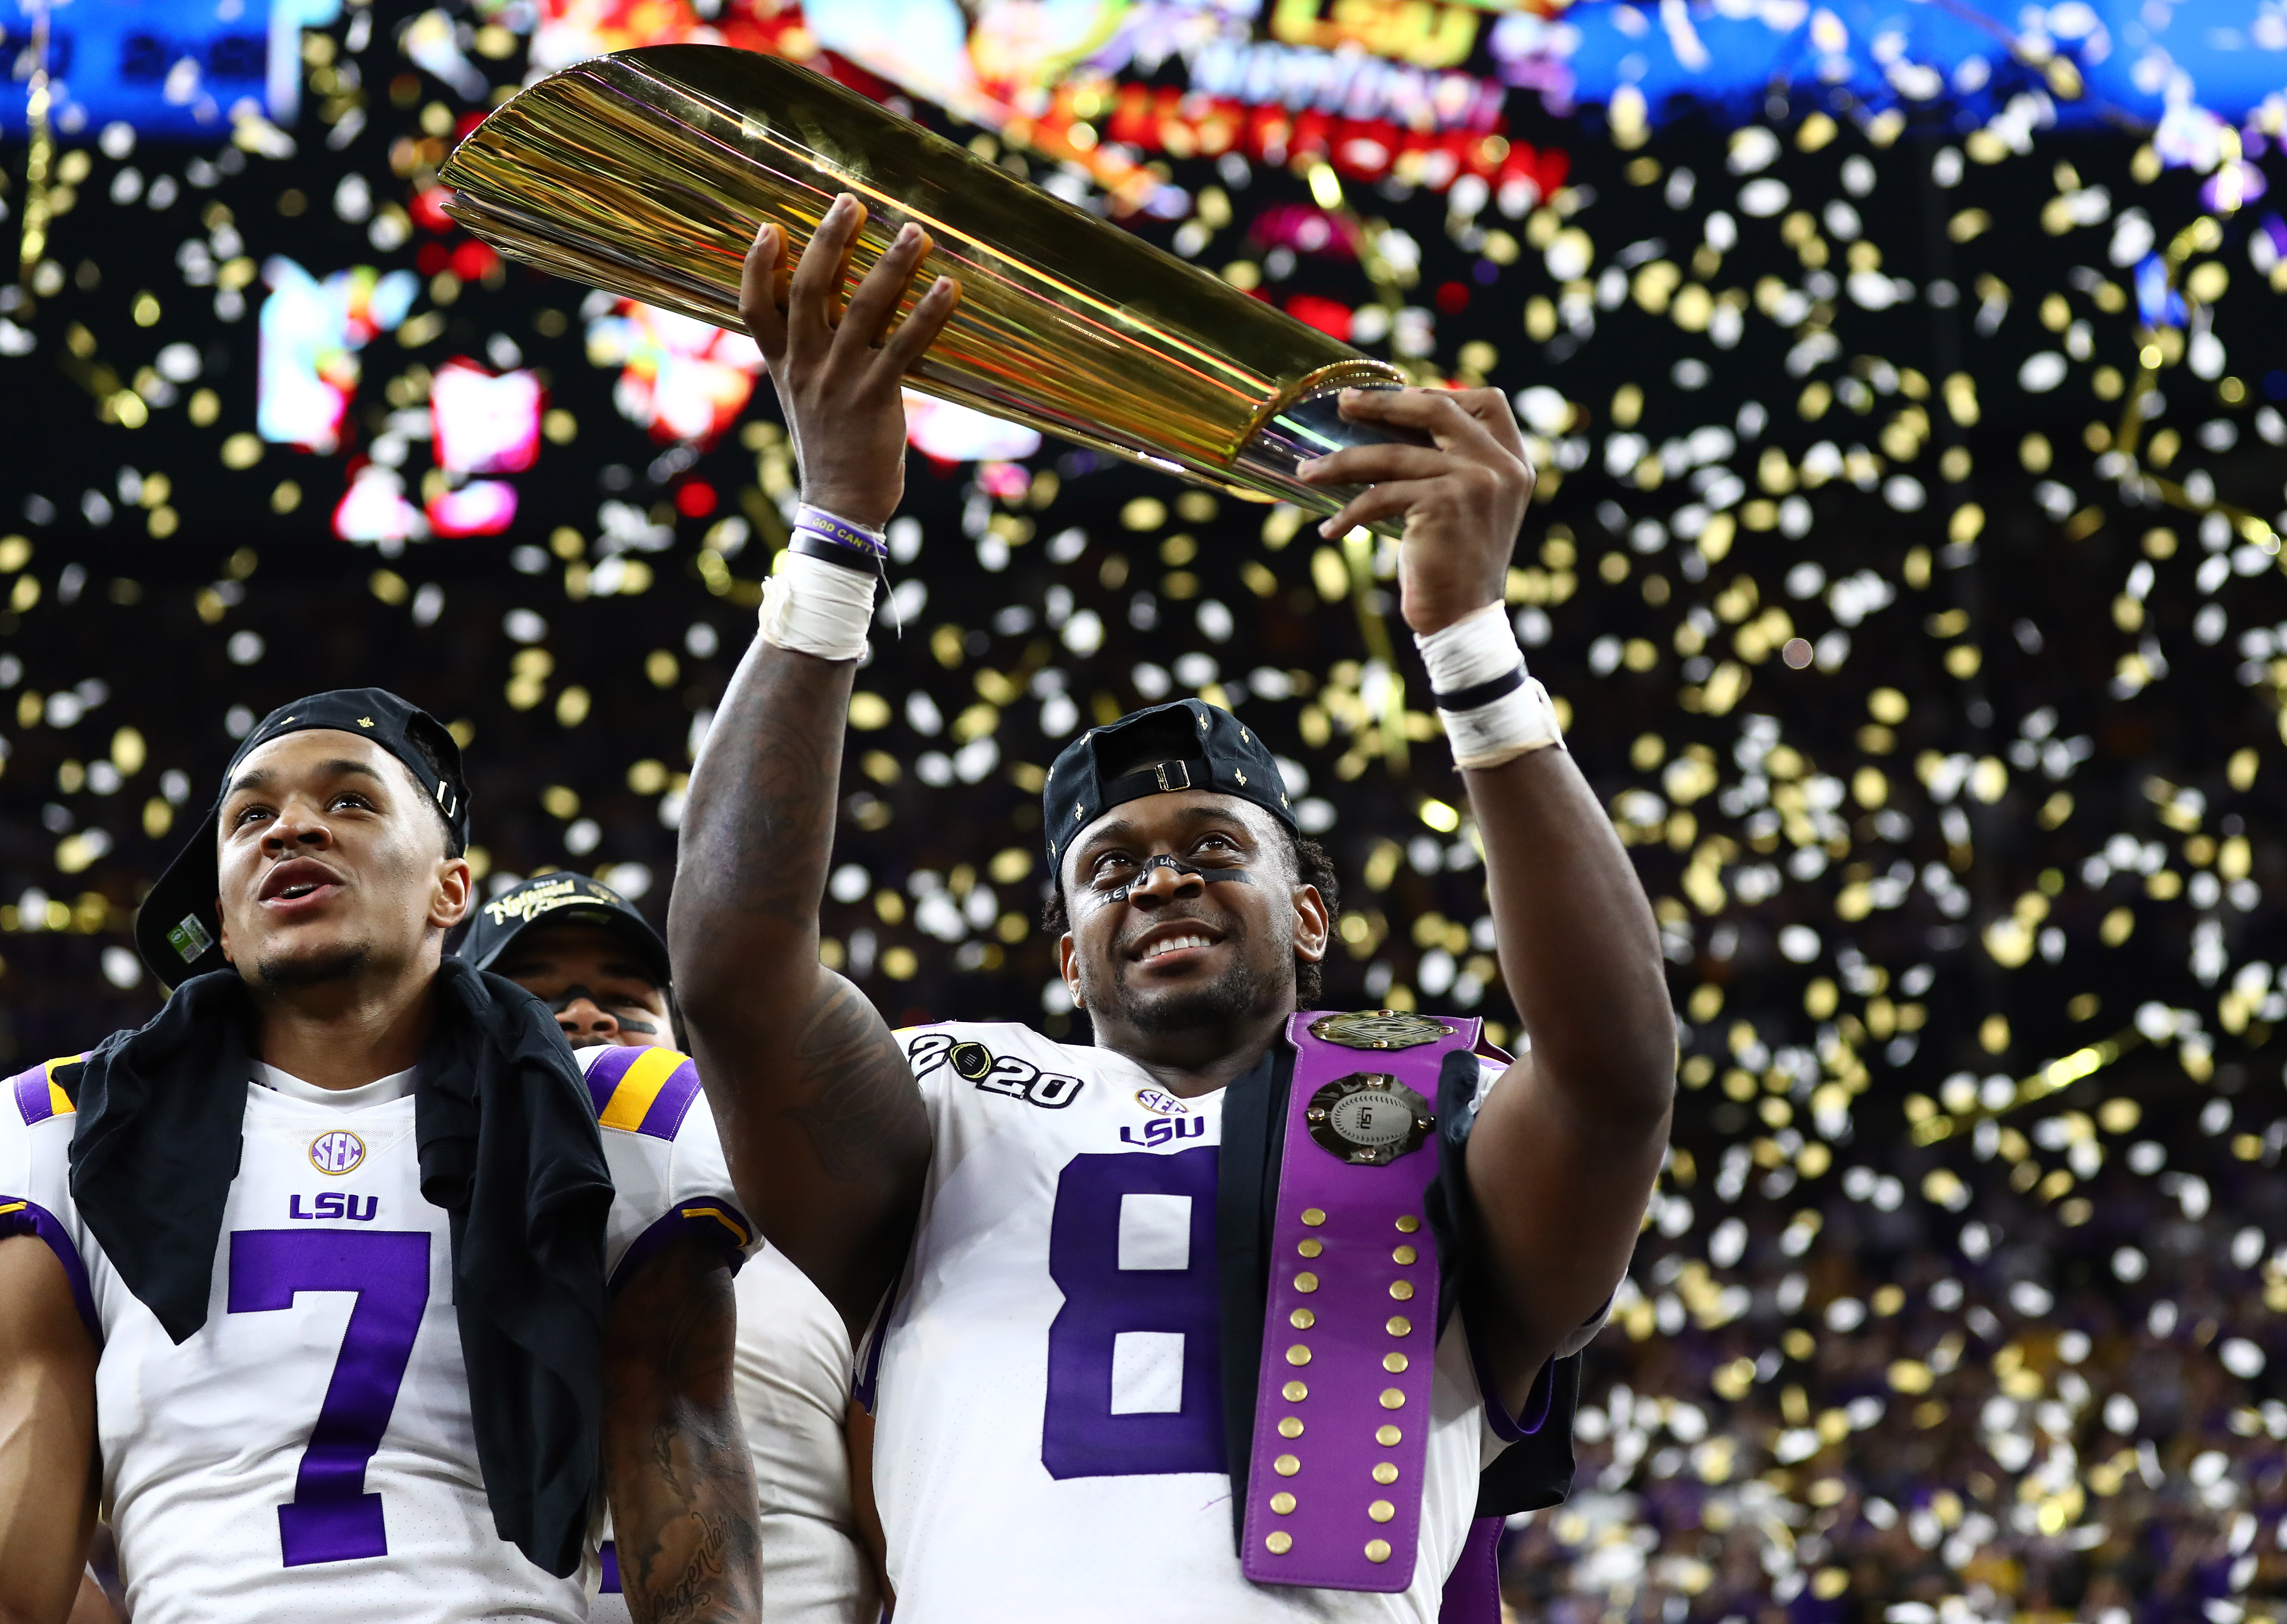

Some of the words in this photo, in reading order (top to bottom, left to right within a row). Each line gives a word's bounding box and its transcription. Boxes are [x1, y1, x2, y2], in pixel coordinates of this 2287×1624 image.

[812, 517, 835, 532] GOD
[1138, 1090, 1187, 1115] SEC
[1120, 1116, 1204, 1147] LSU
[1361, 1107, 1372, 1129] LSU
[312, 1133, 362, 1171] SEC
[290, 1192, 378, 1221] LSU
[1041, 1145, 1231, 1480] 8
[227, 1228, 431, 1567] 7
